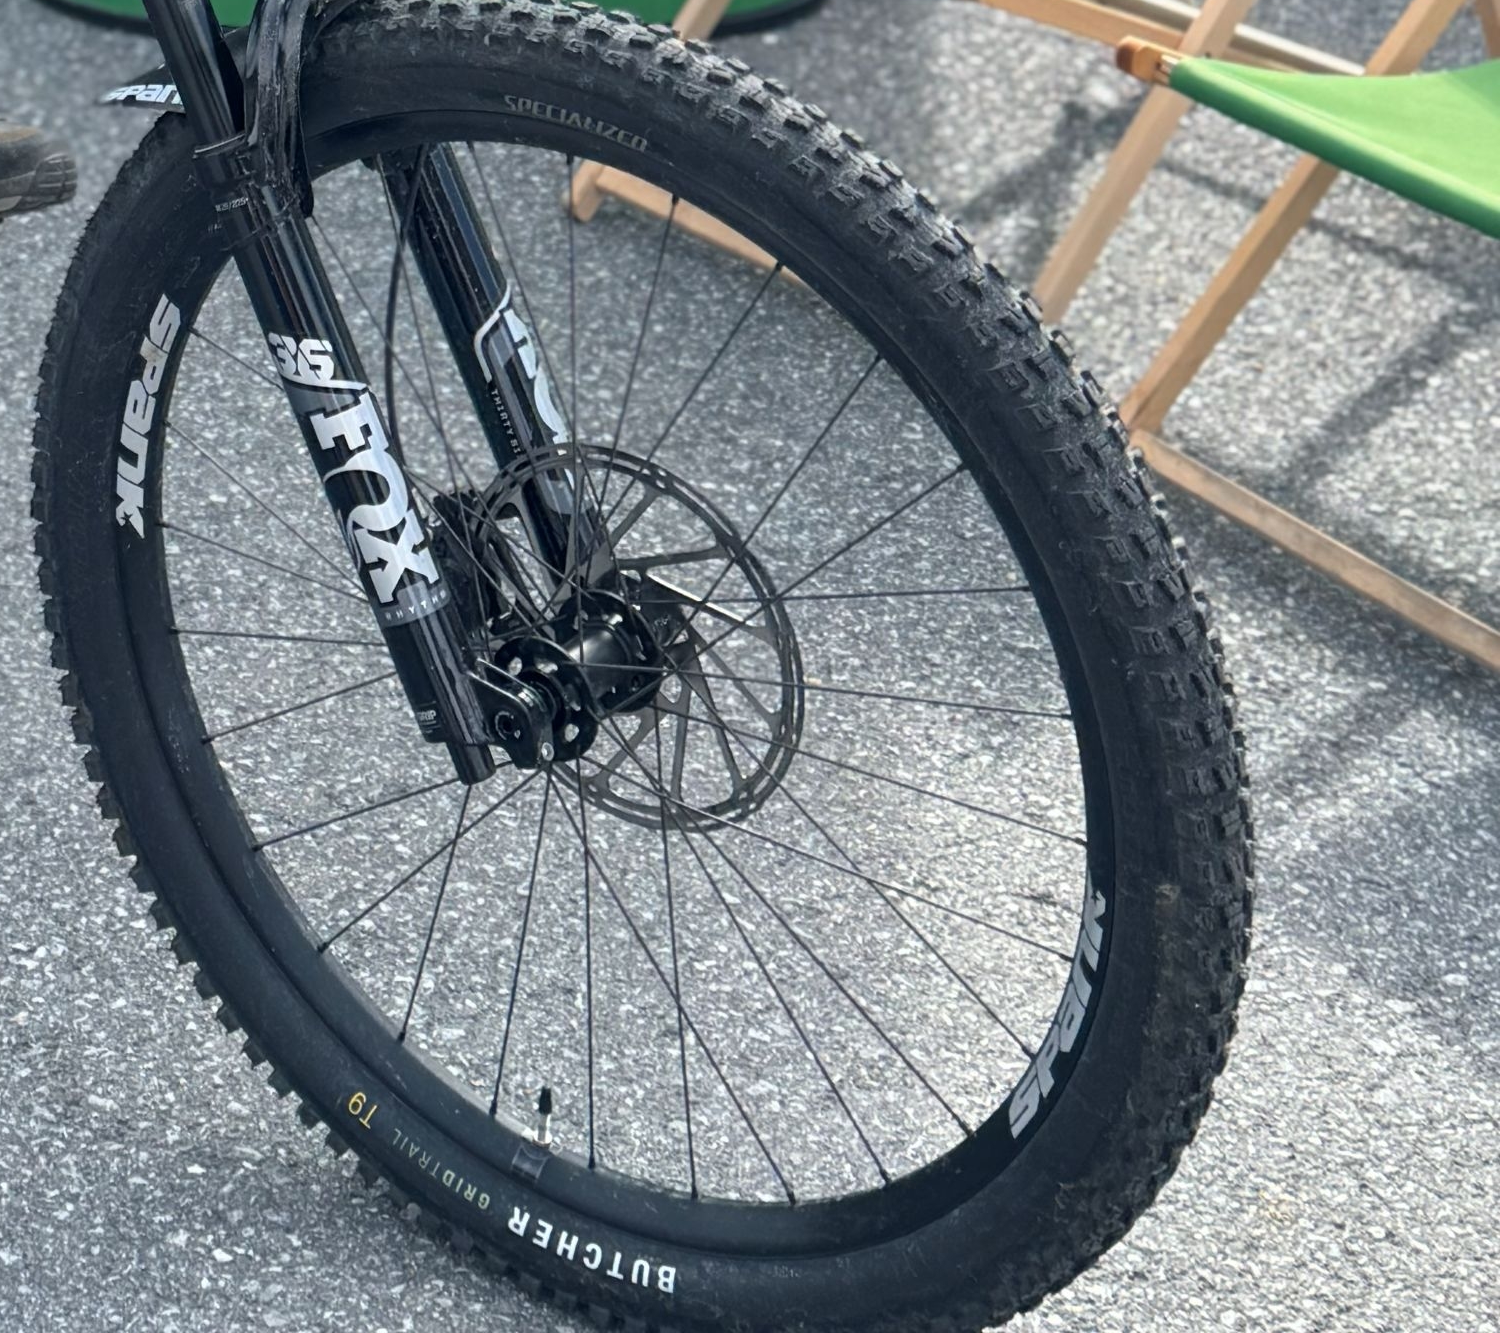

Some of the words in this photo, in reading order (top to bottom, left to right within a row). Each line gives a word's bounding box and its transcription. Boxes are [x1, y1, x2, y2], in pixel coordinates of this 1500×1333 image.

[503, 94, 649, 153] SPECIALIZED
[268, 332, 336, 381] 36
[309, 390, 441, 605] FOX
[347, 1091, 380, 1130] T9
[506, 1205, 678, 1294] BUTCHER
